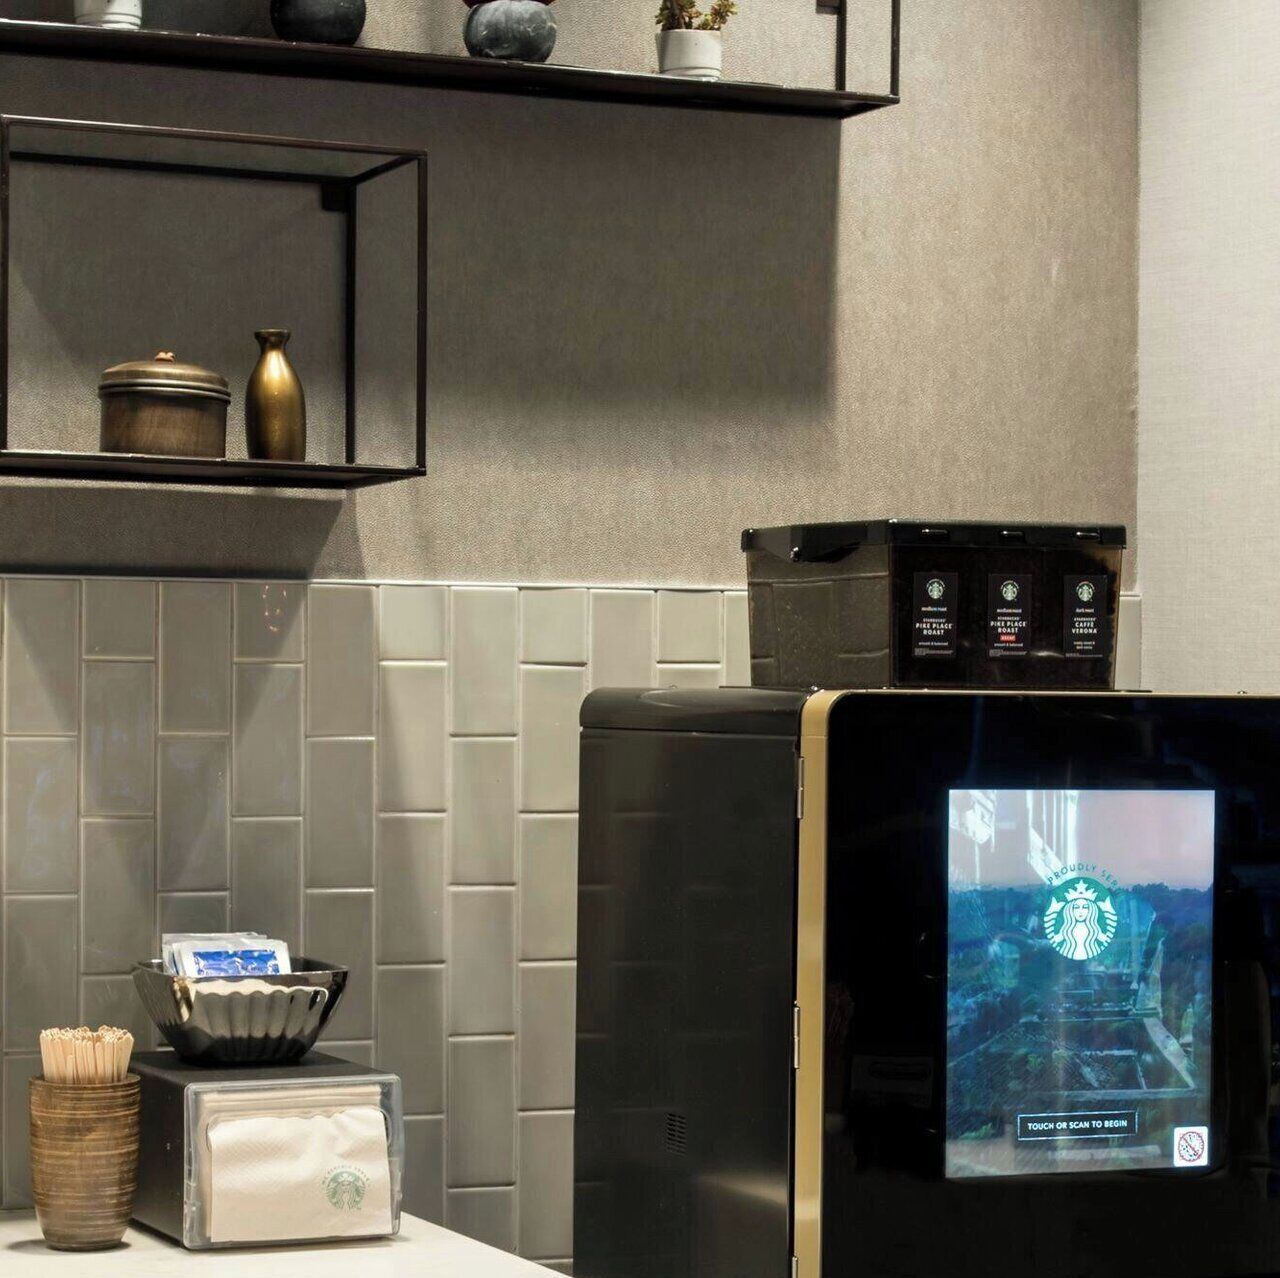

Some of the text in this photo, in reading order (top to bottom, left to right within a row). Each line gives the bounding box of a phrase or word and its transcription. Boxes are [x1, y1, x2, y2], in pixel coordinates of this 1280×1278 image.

[1048, 863, 1097, 885] PROUDLY
[1028, 1122, 1054, 1131] TOUCH
[1056, 1121, 1067, 1129] OR
[1069, 1120, 1090, 1129] SCAN
[1104, 1120, 1128, 1128] BEGIN
